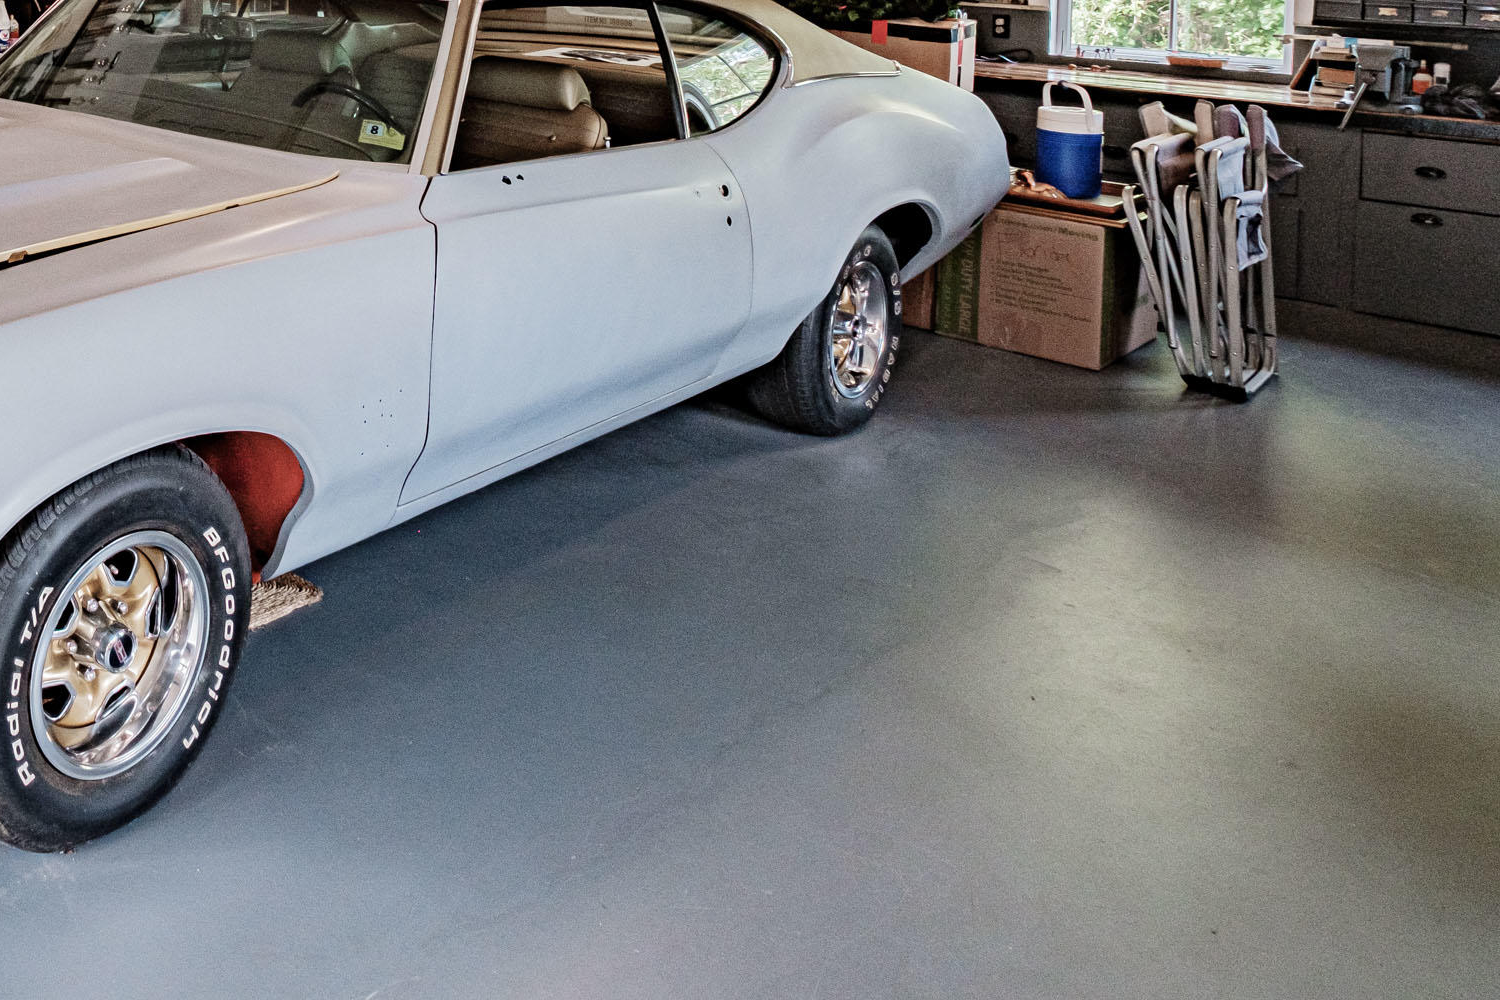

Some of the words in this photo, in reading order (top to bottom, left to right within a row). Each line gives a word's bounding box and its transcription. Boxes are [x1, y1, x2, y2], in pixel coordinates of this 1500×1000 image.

[370, 125, 379, 135] 8
[19, 584, 55, 645] T/A
[182, 526, 236, 750] BFGoodrich
[6, 658, 36, 787] Radial
